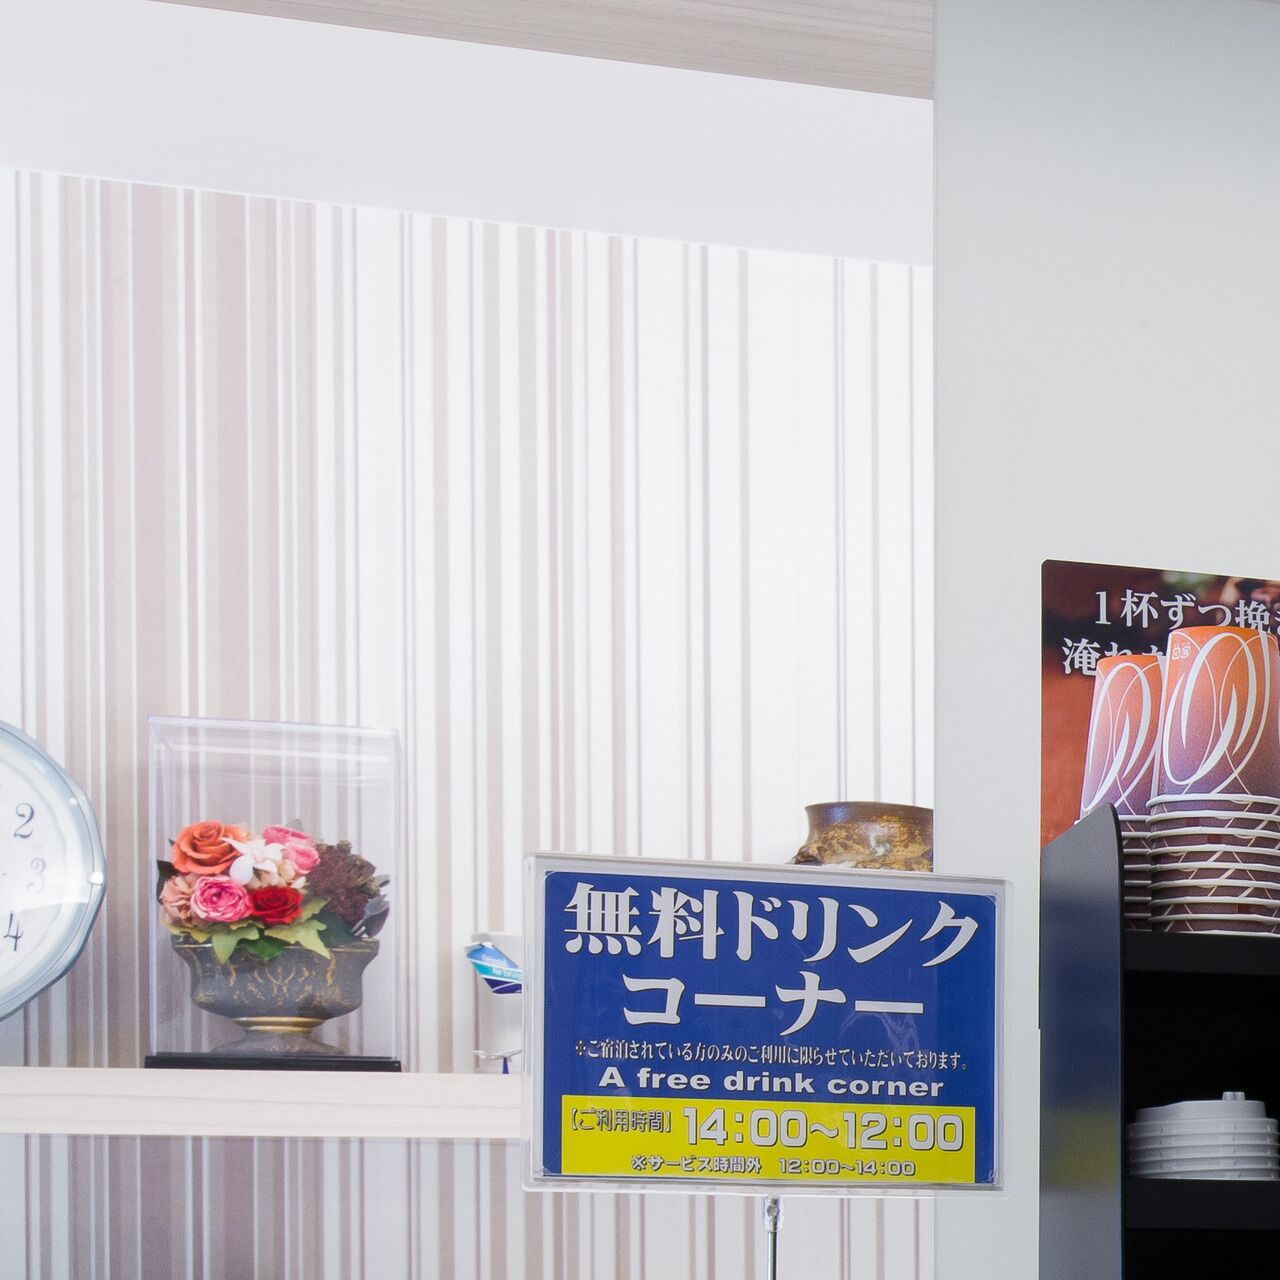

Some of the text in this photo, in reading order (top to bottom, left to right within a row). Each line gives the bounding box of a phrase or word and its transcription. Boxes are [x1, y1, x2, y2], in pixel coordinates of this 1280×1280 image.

[14, 802, 34, 838] 2
[26, 858, 46, 896] 3
[3, 911, 24, 952] 4
[563, 881, 979, 968] 無料ドリンク
[622, 971, 924, 1036] コーナー
[598, 1068, 944, 1097] A free drink corner
[567, 1108, 674, 1135] 【ご利用時間】
[631, 1155, 762, 1174] ※サービス時間外
